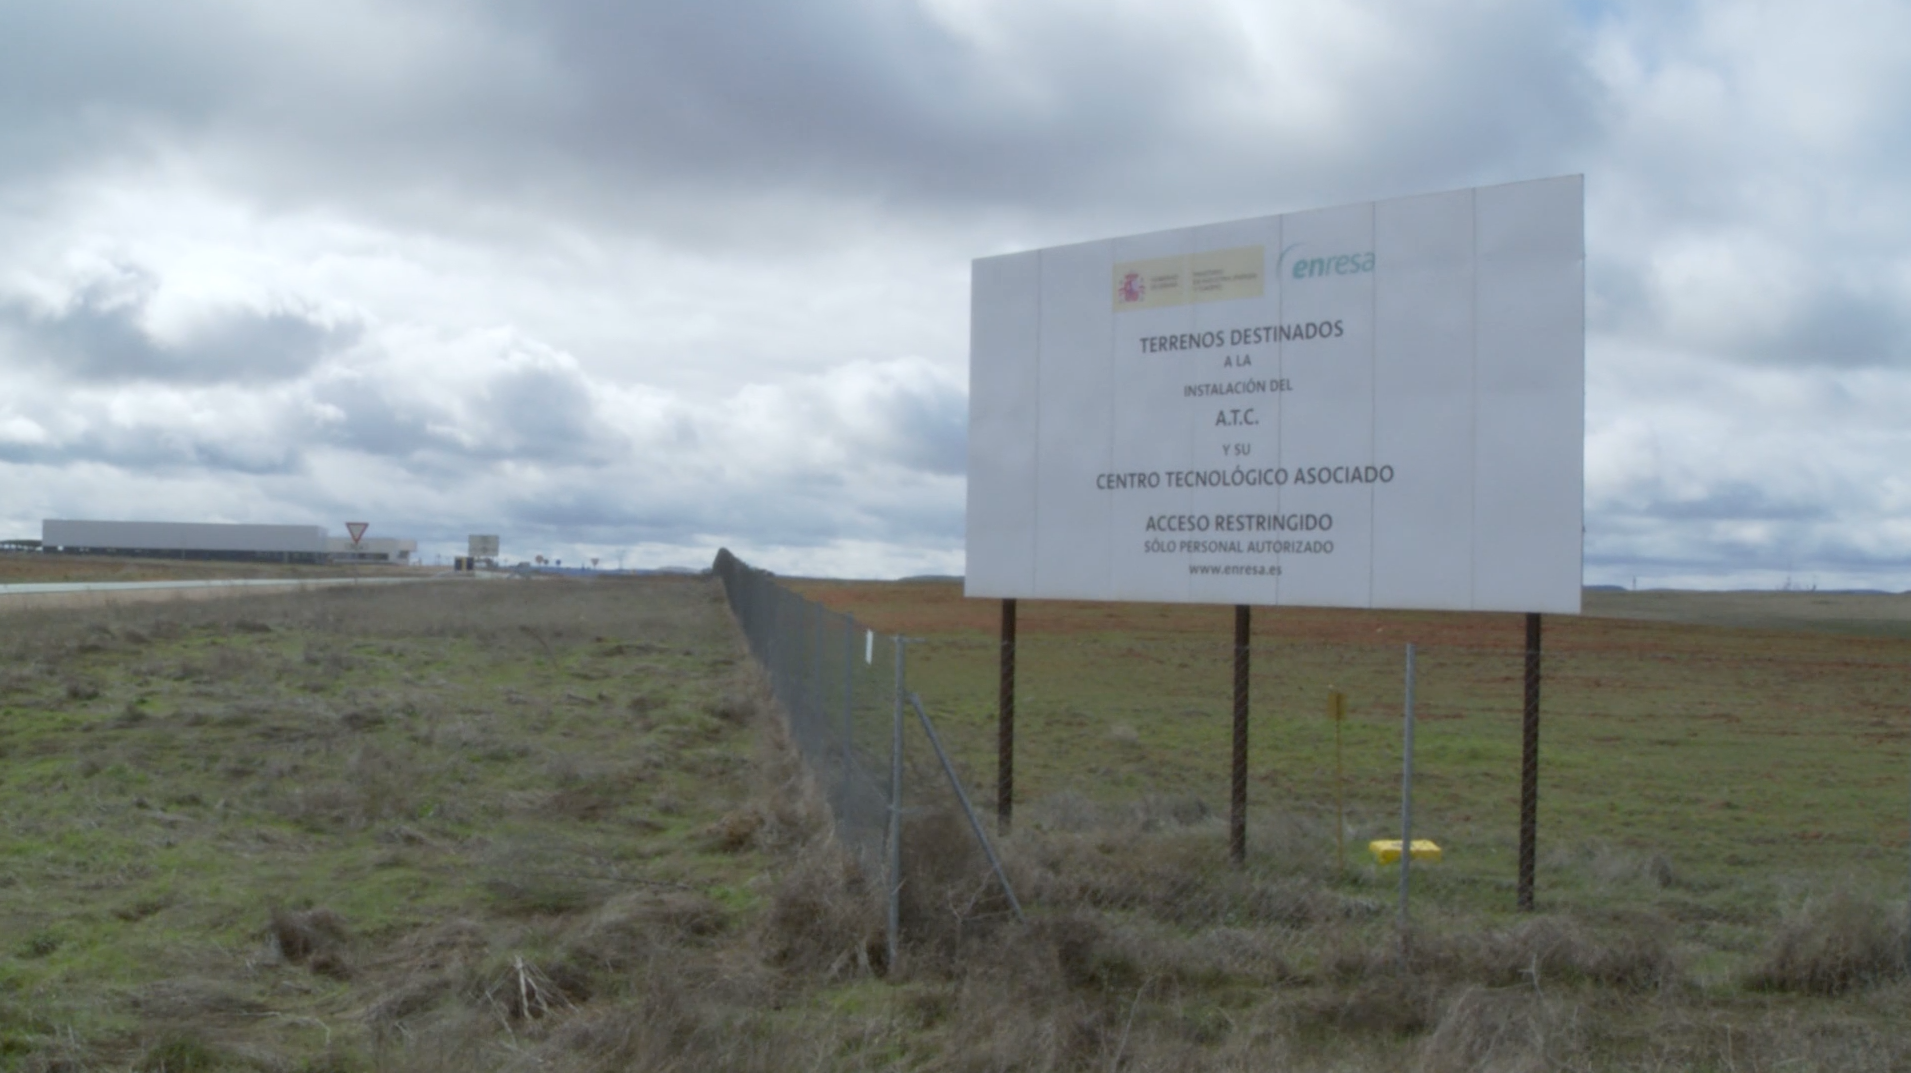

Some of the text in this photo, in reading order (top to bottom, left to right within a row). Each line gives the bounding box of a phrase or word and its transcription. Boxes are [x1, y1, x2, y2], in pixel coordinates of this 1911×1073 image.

[1139, 319, 1345, 353] TERRENOS DESTINADOS
[1224, 354, 1252, 368] A LA
[1183, 377, 1294, 398] INSTALACIÓN DEL
[1215, 408, 1260, 426] A.T.C.
[1222, 443, 1251, 456] Y SU
[1096, 464, 1395, 490] CENTRO TECNOLÓGICO ASOCIADO
[1146, 513, 1334, 532] ACCESO RESTRINGIDO
[1144, 538, 1335, 554] SÓLO PERSONAL AUTORIZADO
[1188, 564, 1283, 577] www.enresa.es
